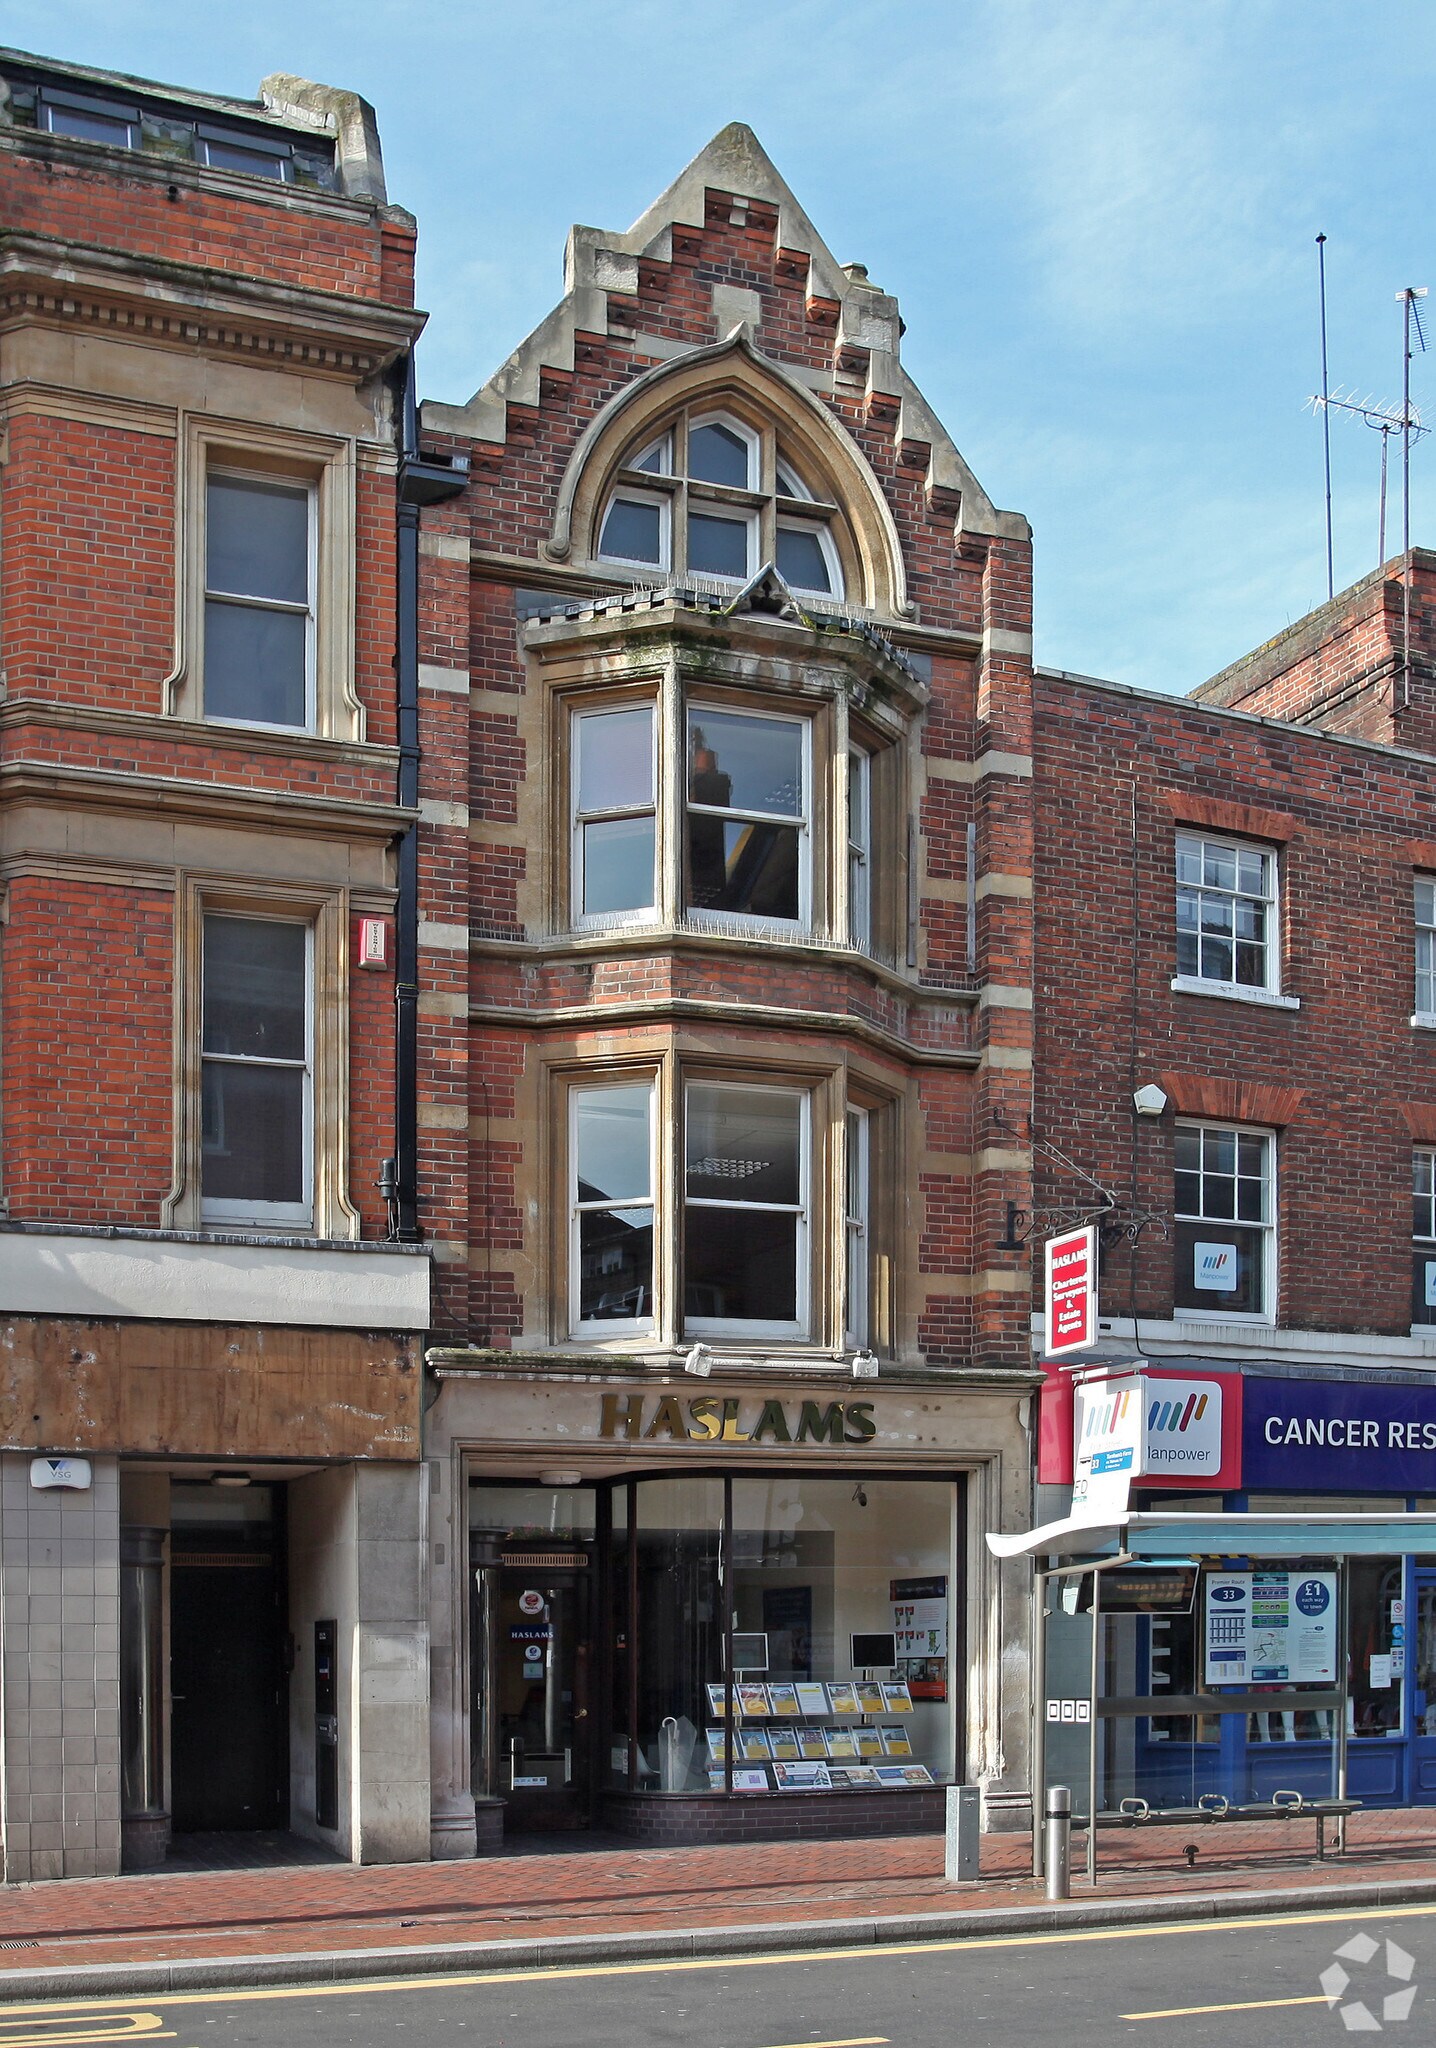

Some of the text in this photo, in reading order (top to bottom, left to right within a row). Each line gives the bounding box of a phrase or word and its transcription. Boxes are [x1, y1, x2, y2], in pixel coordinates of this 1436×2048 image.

[1052, 1248, 1088, 1270] HASLAMS
[1052, 1272, 1088, 1291] Chartered
[1053, 1285, 1087, 1302] Surveyors
[1065, 1299, 1074, 1309] &
[1059, 1309, 1082, 1322] Estate
[1057, 1320, 1082, 1334] Agents
[598, 1393, 877, 1444] HASLAMS
[1264, 1416, 1436, 1450] CANCER RES
[1147, 1446, 1211, 1463] anpower
[51, 1471, 72, 1479] VSG
[1223, 1590, 1235, 1600] 33
[1305, 1583, 1321, 1596] £1
[511, 1631, 554, 1639] HASLAMS
